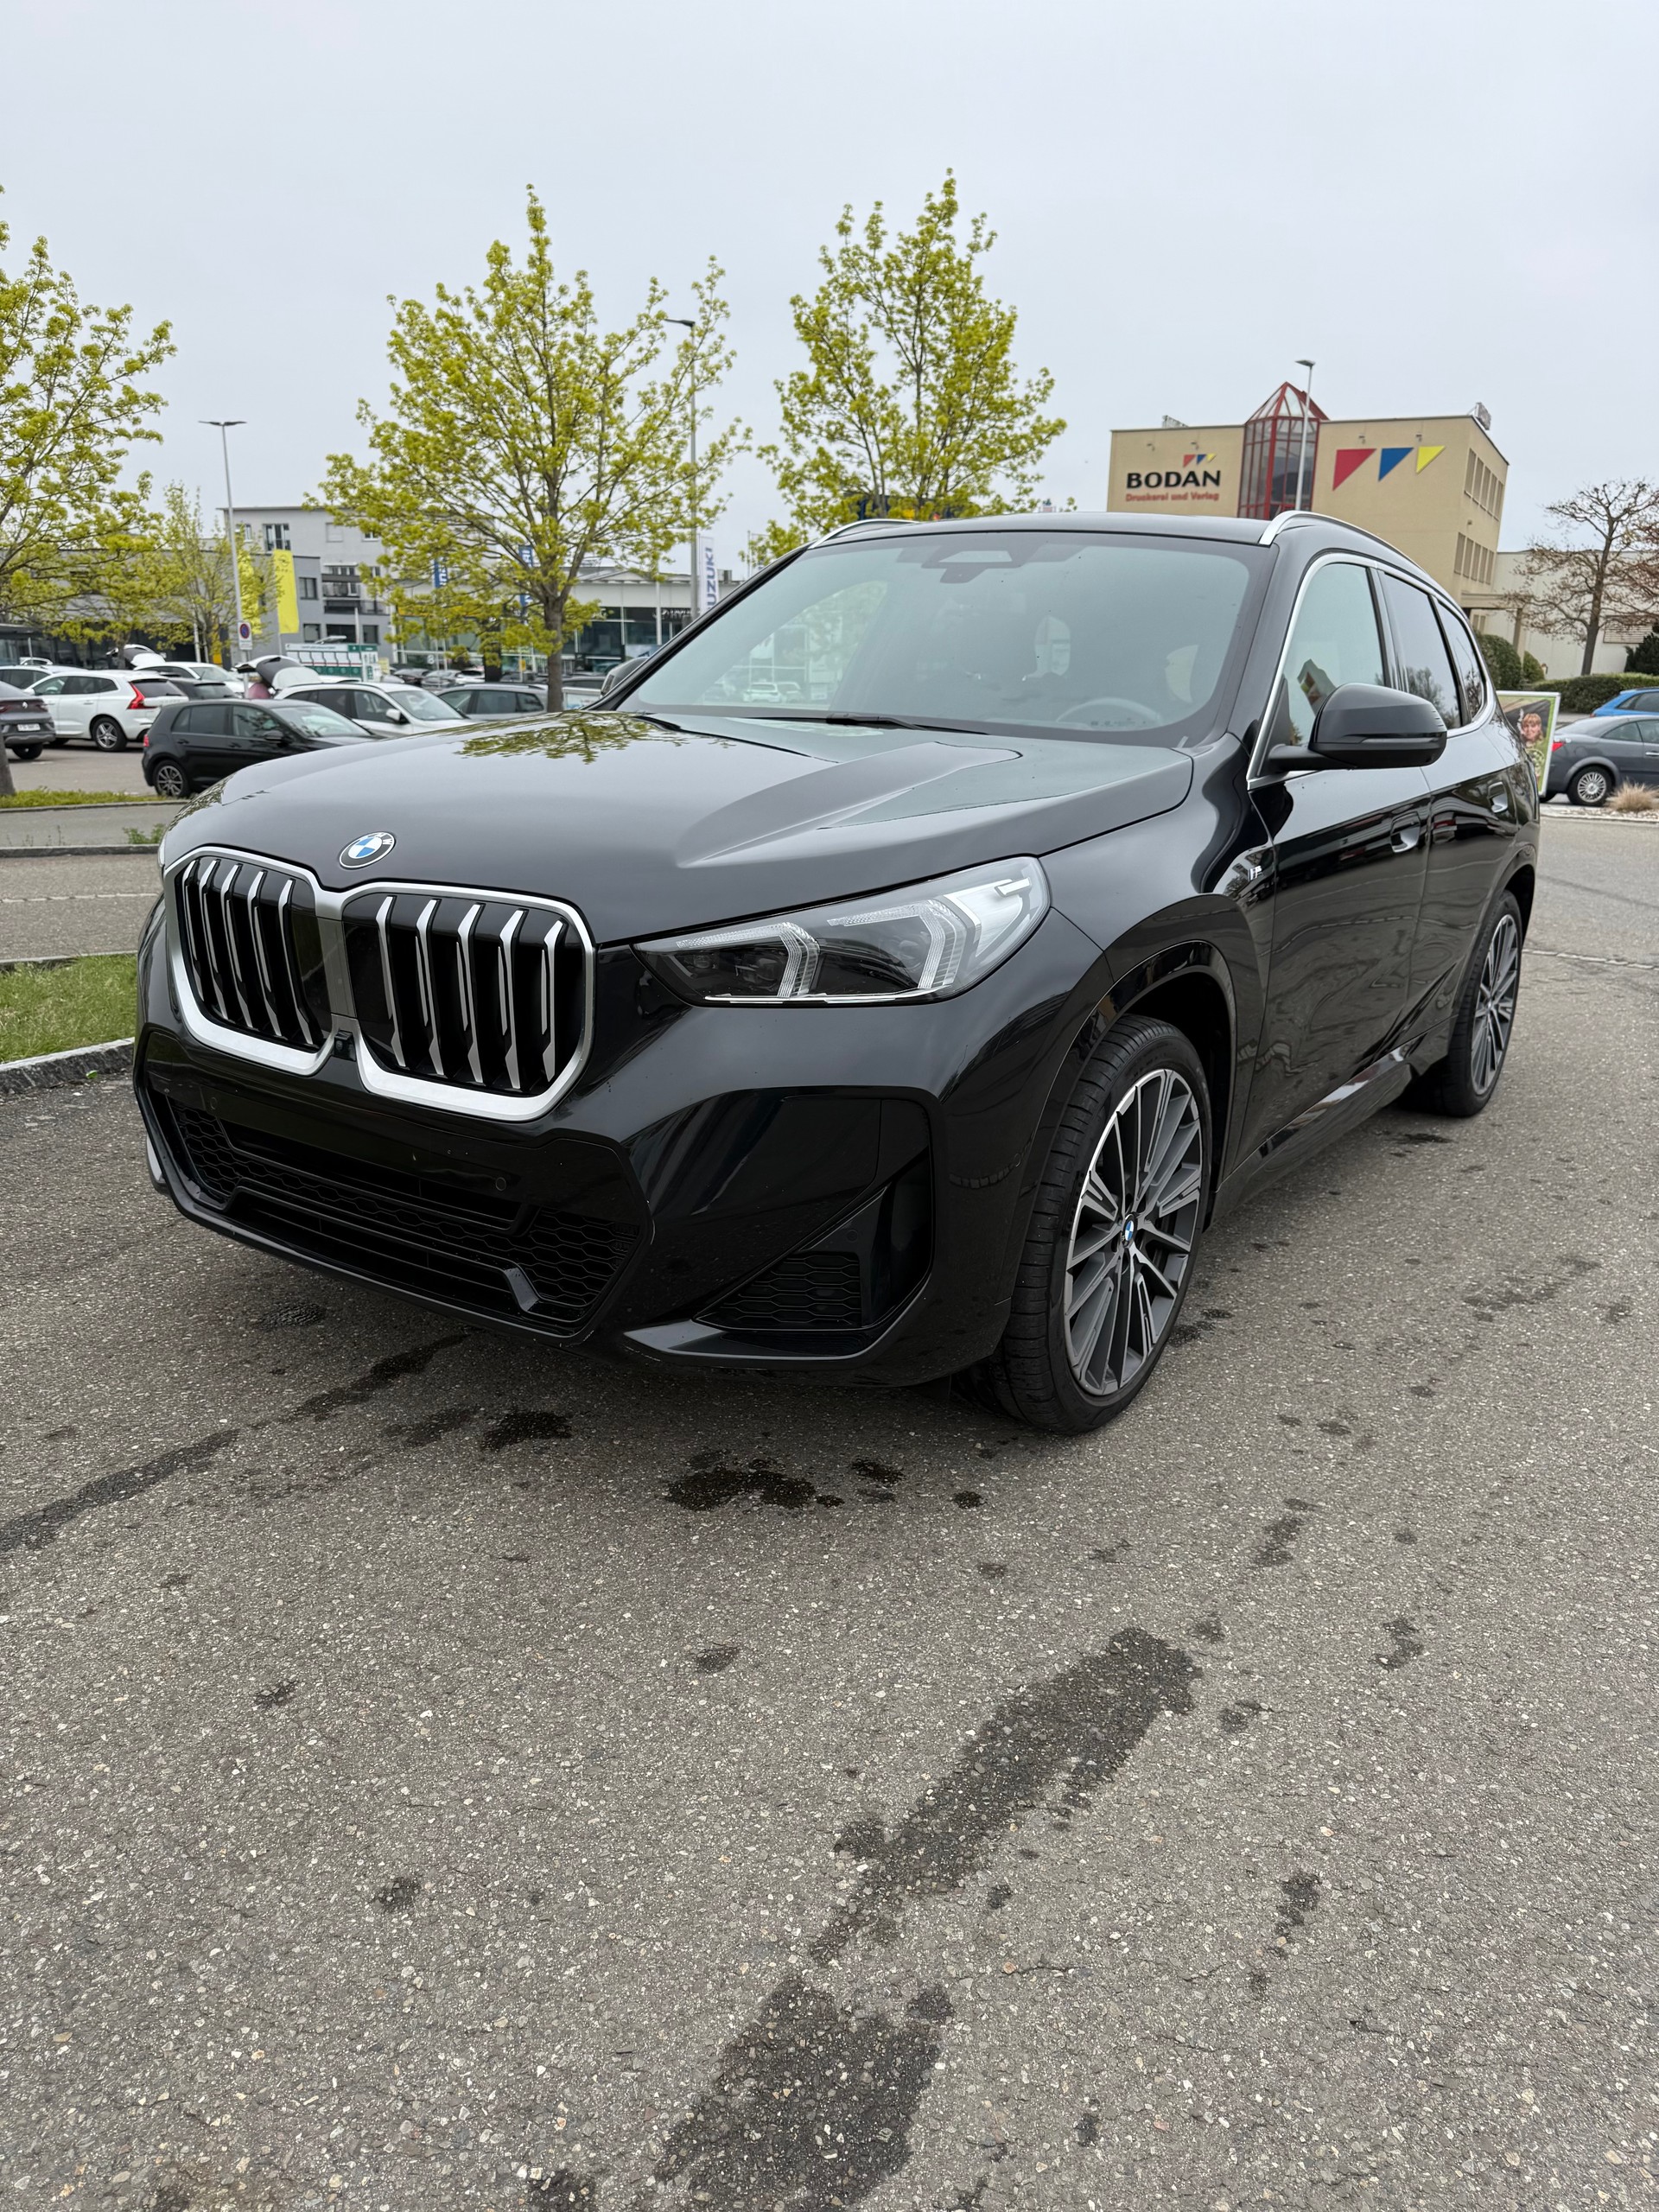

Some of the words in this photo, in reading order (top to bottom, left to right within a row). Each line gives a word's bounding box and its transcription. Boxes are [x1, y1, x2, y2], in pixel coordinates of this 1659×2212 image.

[1126, 470, 1221, 489] BODAN
[1126, 493, 1169, 501] Druckerei
[1171, 493, 1188, 501] und
[1191, 492, 1219, 501] Verlag
[705, 547, 717, 611] UZUKI
